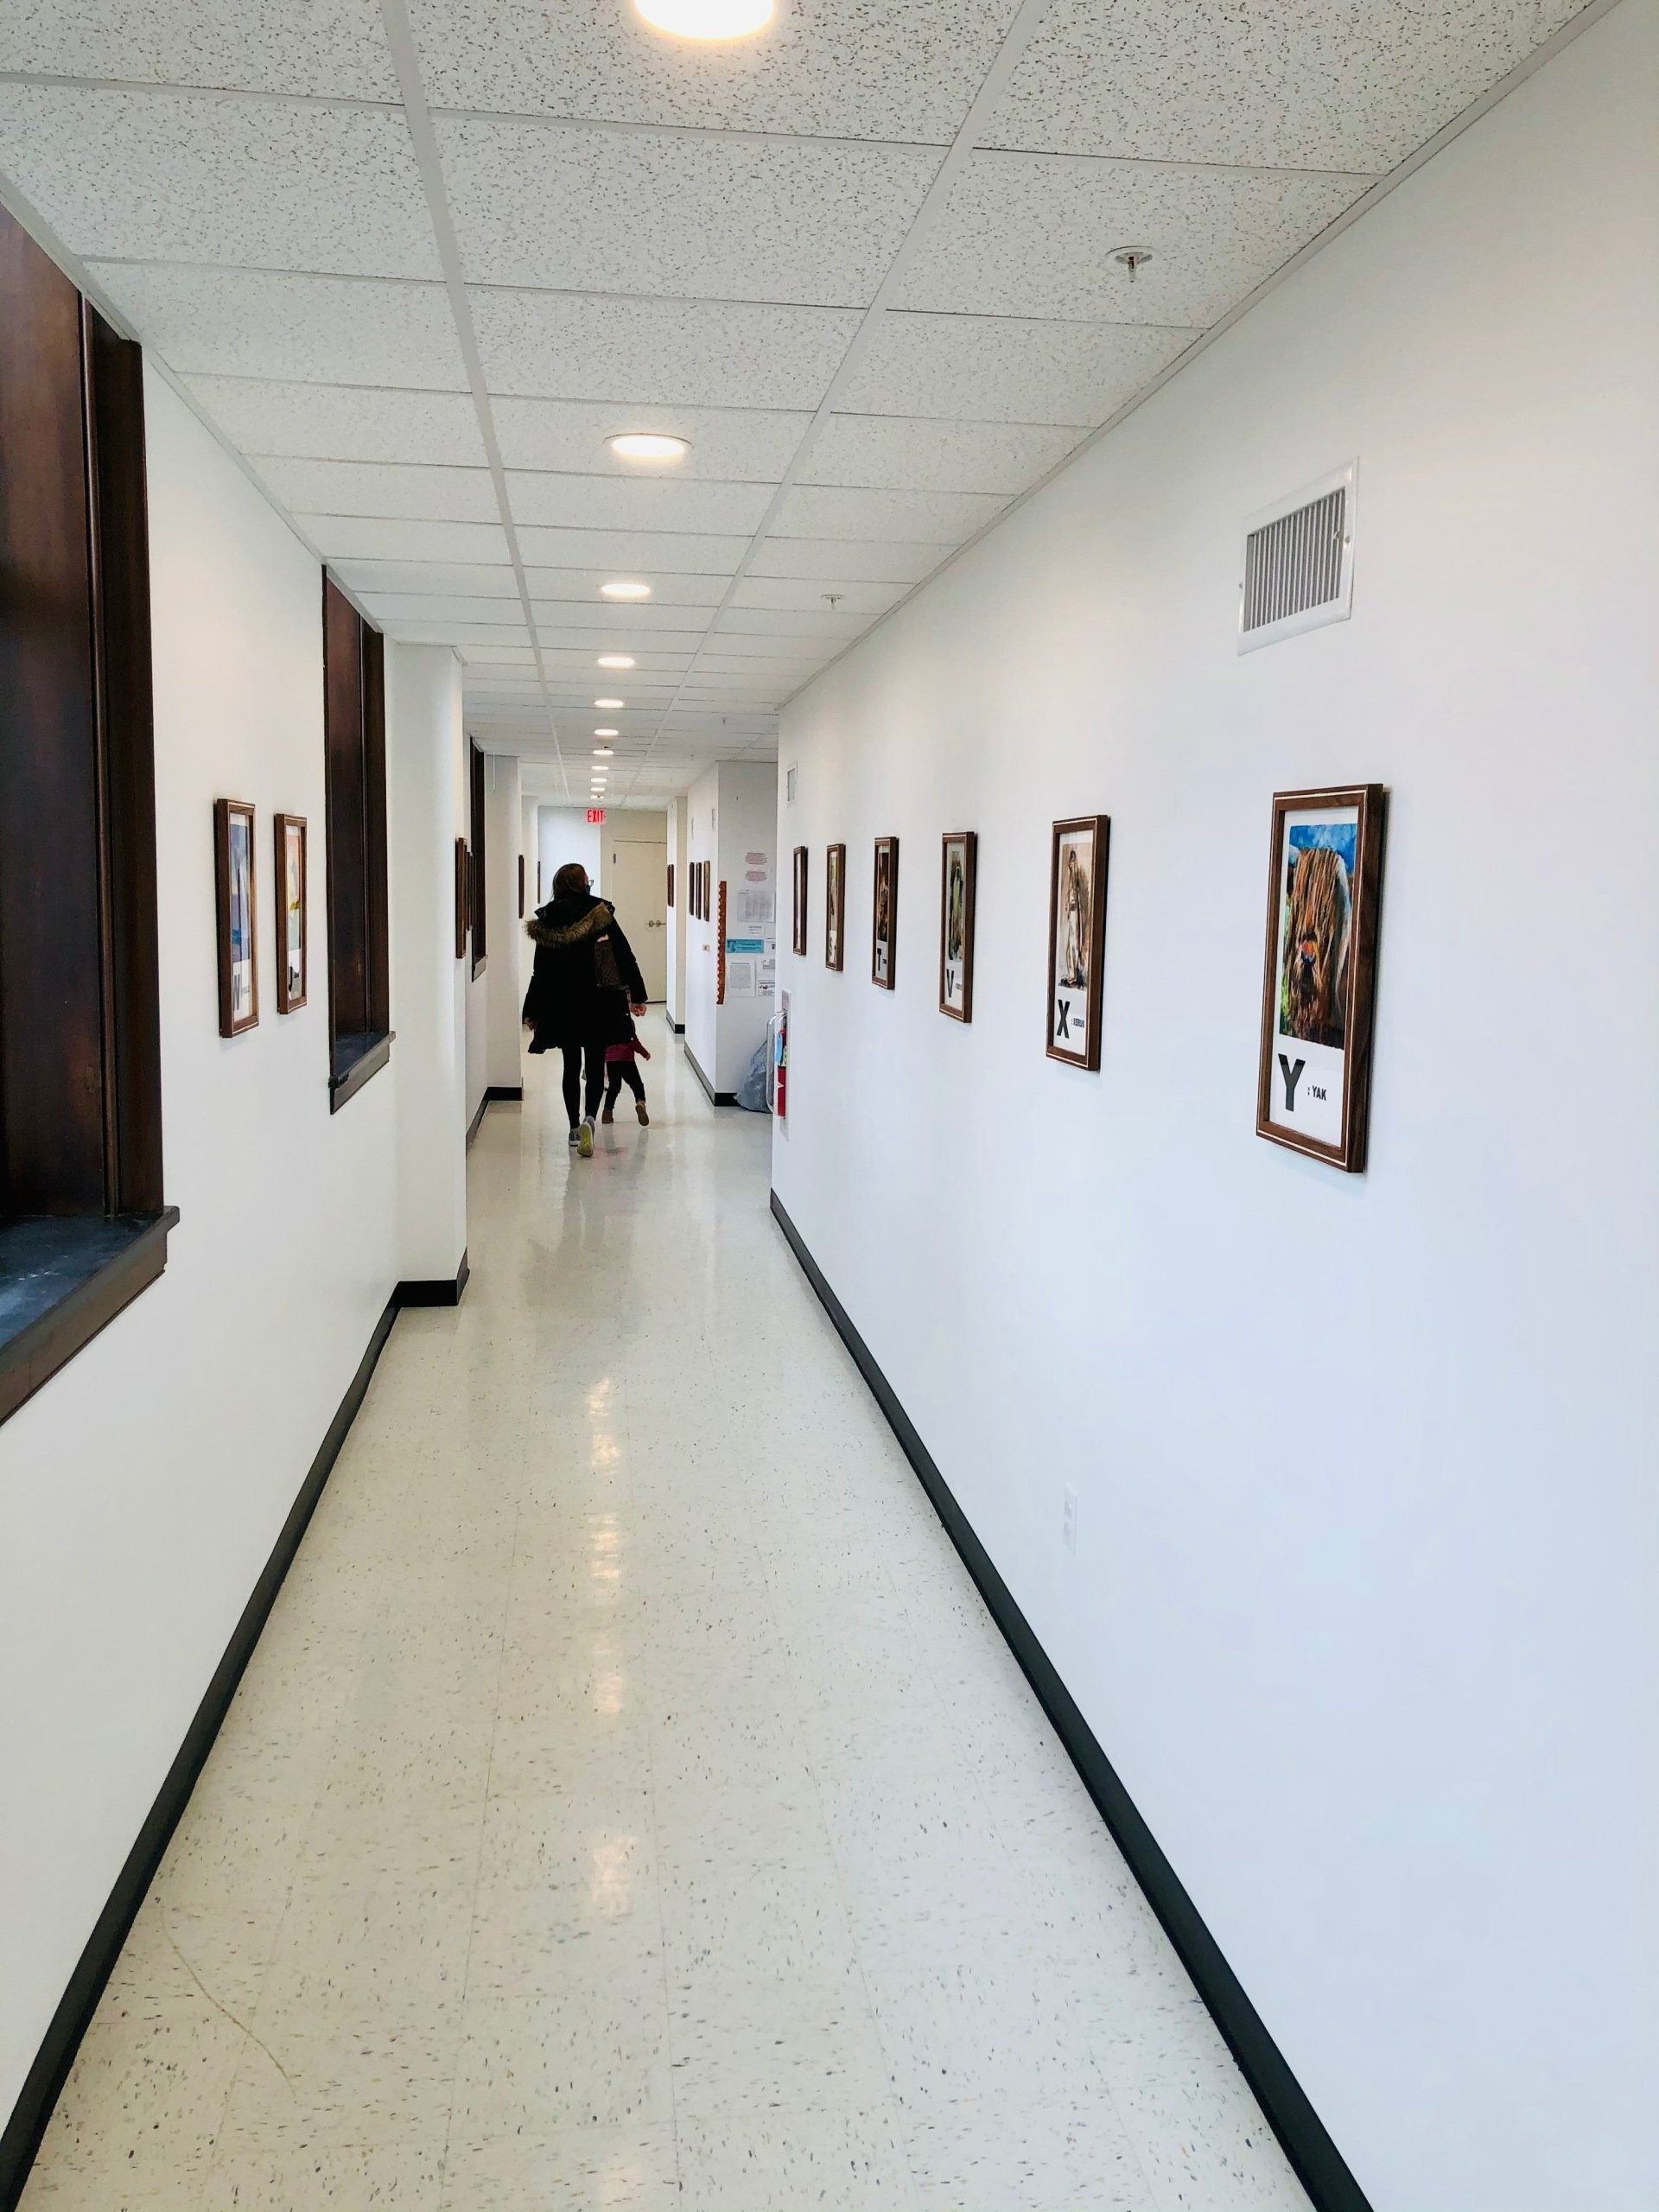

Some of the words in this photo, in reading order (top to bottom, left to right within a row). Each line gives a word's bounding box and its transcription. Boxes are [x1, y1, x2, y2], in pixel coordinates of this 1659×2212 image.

[588, 810, 604, 823] EXIT
[877, 948, 881, 971] T
[946, 969, 954, 997] V
[1057, 999, 1071, 1039] X
[1278, 1053, 1306, 1112] Y
[1312, 1085, 1326, 1101] YAK
